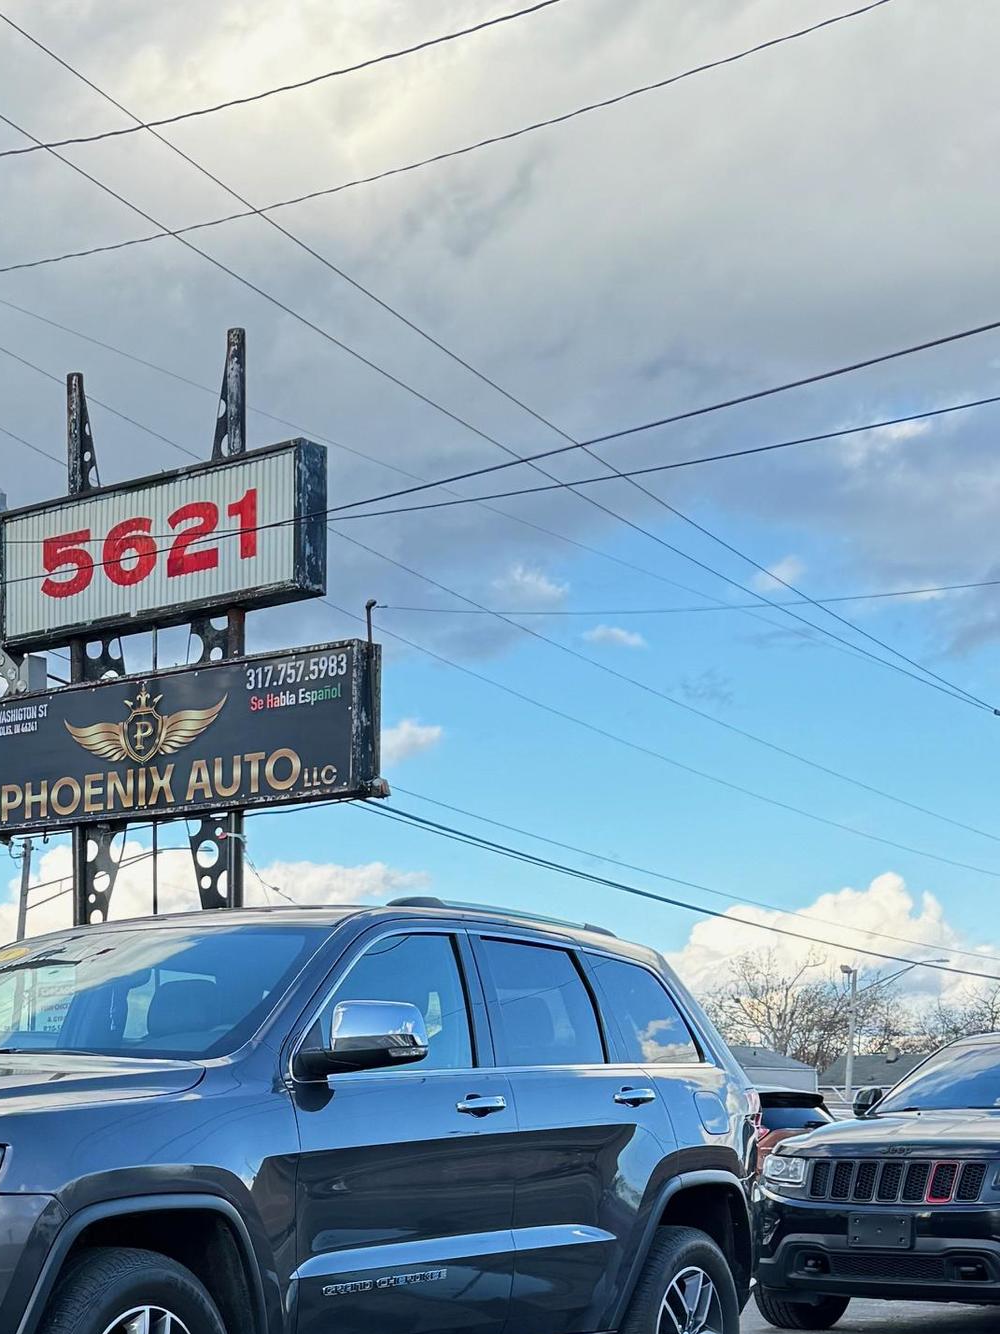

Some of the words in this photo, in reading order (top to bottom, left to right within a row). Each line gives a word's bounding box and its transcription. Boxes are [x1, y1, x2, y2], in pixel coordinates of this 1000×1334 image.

[40, 487, 258, 599] 5621
[246, 653, 347, 690] 317.757.5983
[38, 703, 48, 718] ST
[250, 696, 264, 711] Se
[266, 690, 295, 708] Habla
[298, 682, 342, 705] Español
[133, 721, 154, 750] P
[0, 763, 175, 822] PHOENIX
[186, 747, 301, 801] AUTO
[303, 764, 337, 788] LLC
[322, 1279, 374, 1296] GRAND
[376, 1268, 448, 1289] CHEROKEE
